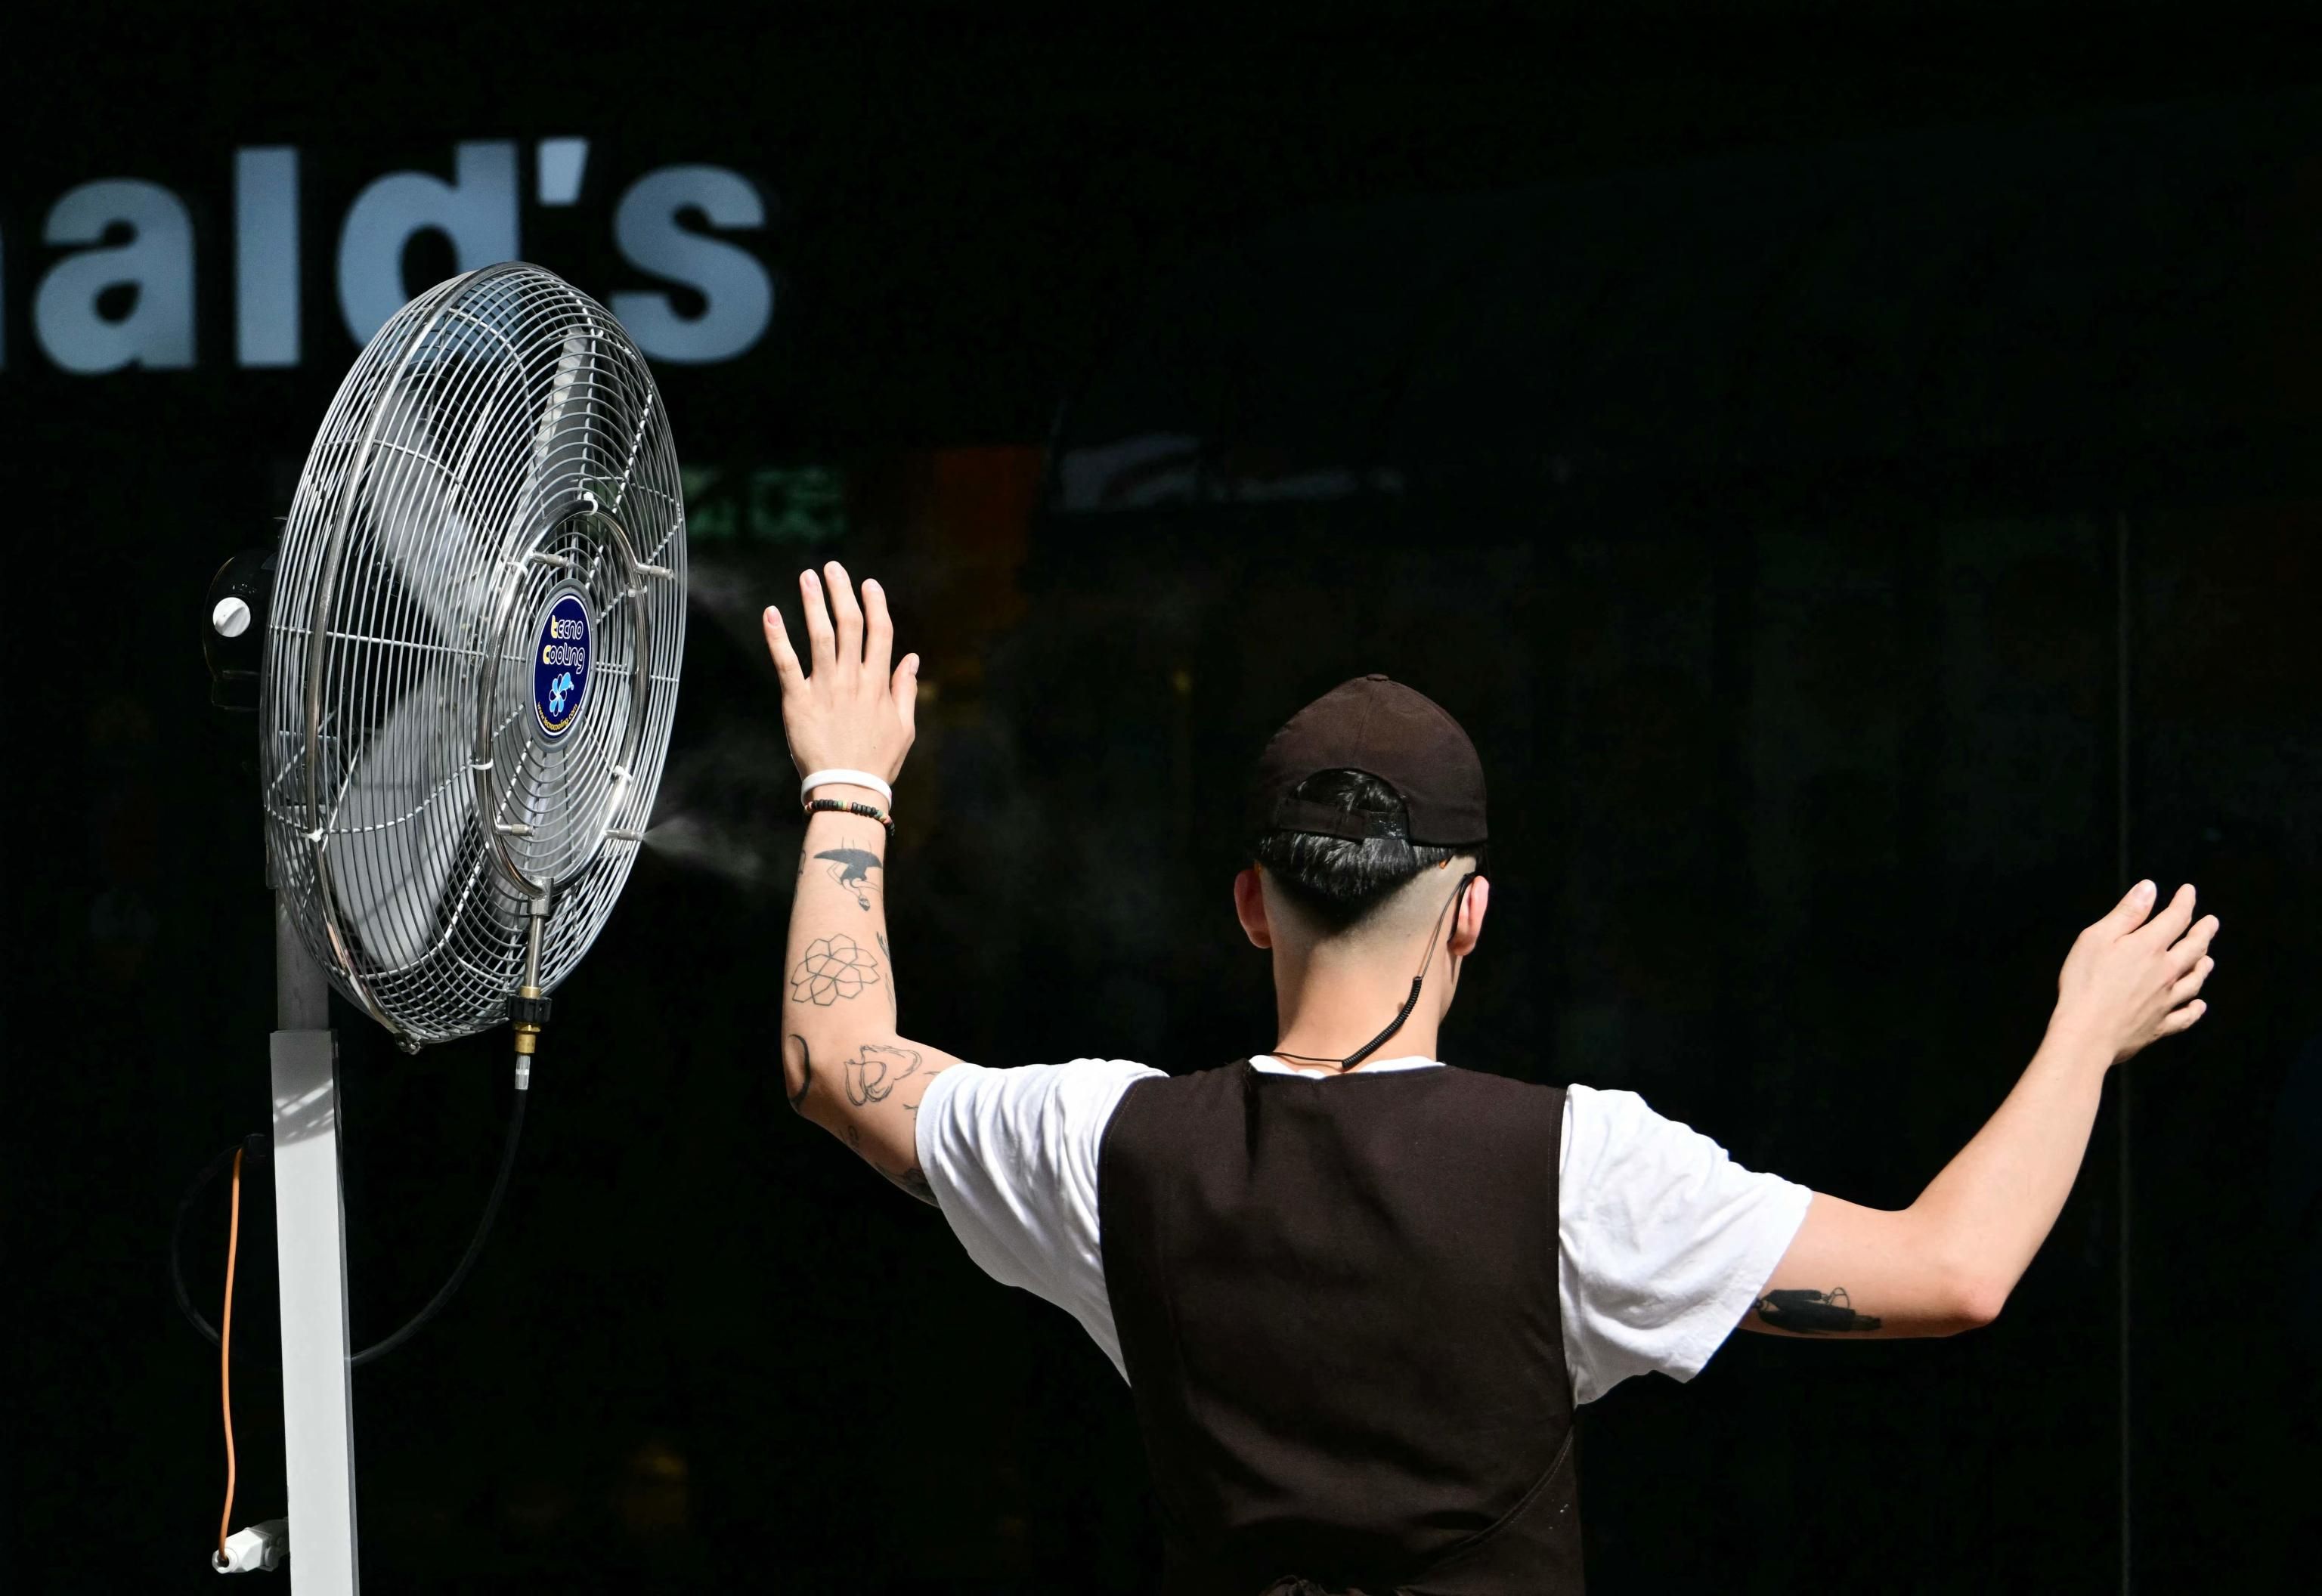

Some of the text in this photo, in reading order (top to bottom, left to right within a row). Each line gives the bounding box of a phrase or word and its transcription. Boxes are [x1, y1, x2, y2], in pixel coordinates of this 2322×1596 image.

[0, 137, 774, 376] ald's
[551, 614, 584, 640] tecno
[543, 642, 585, 675] cooling
